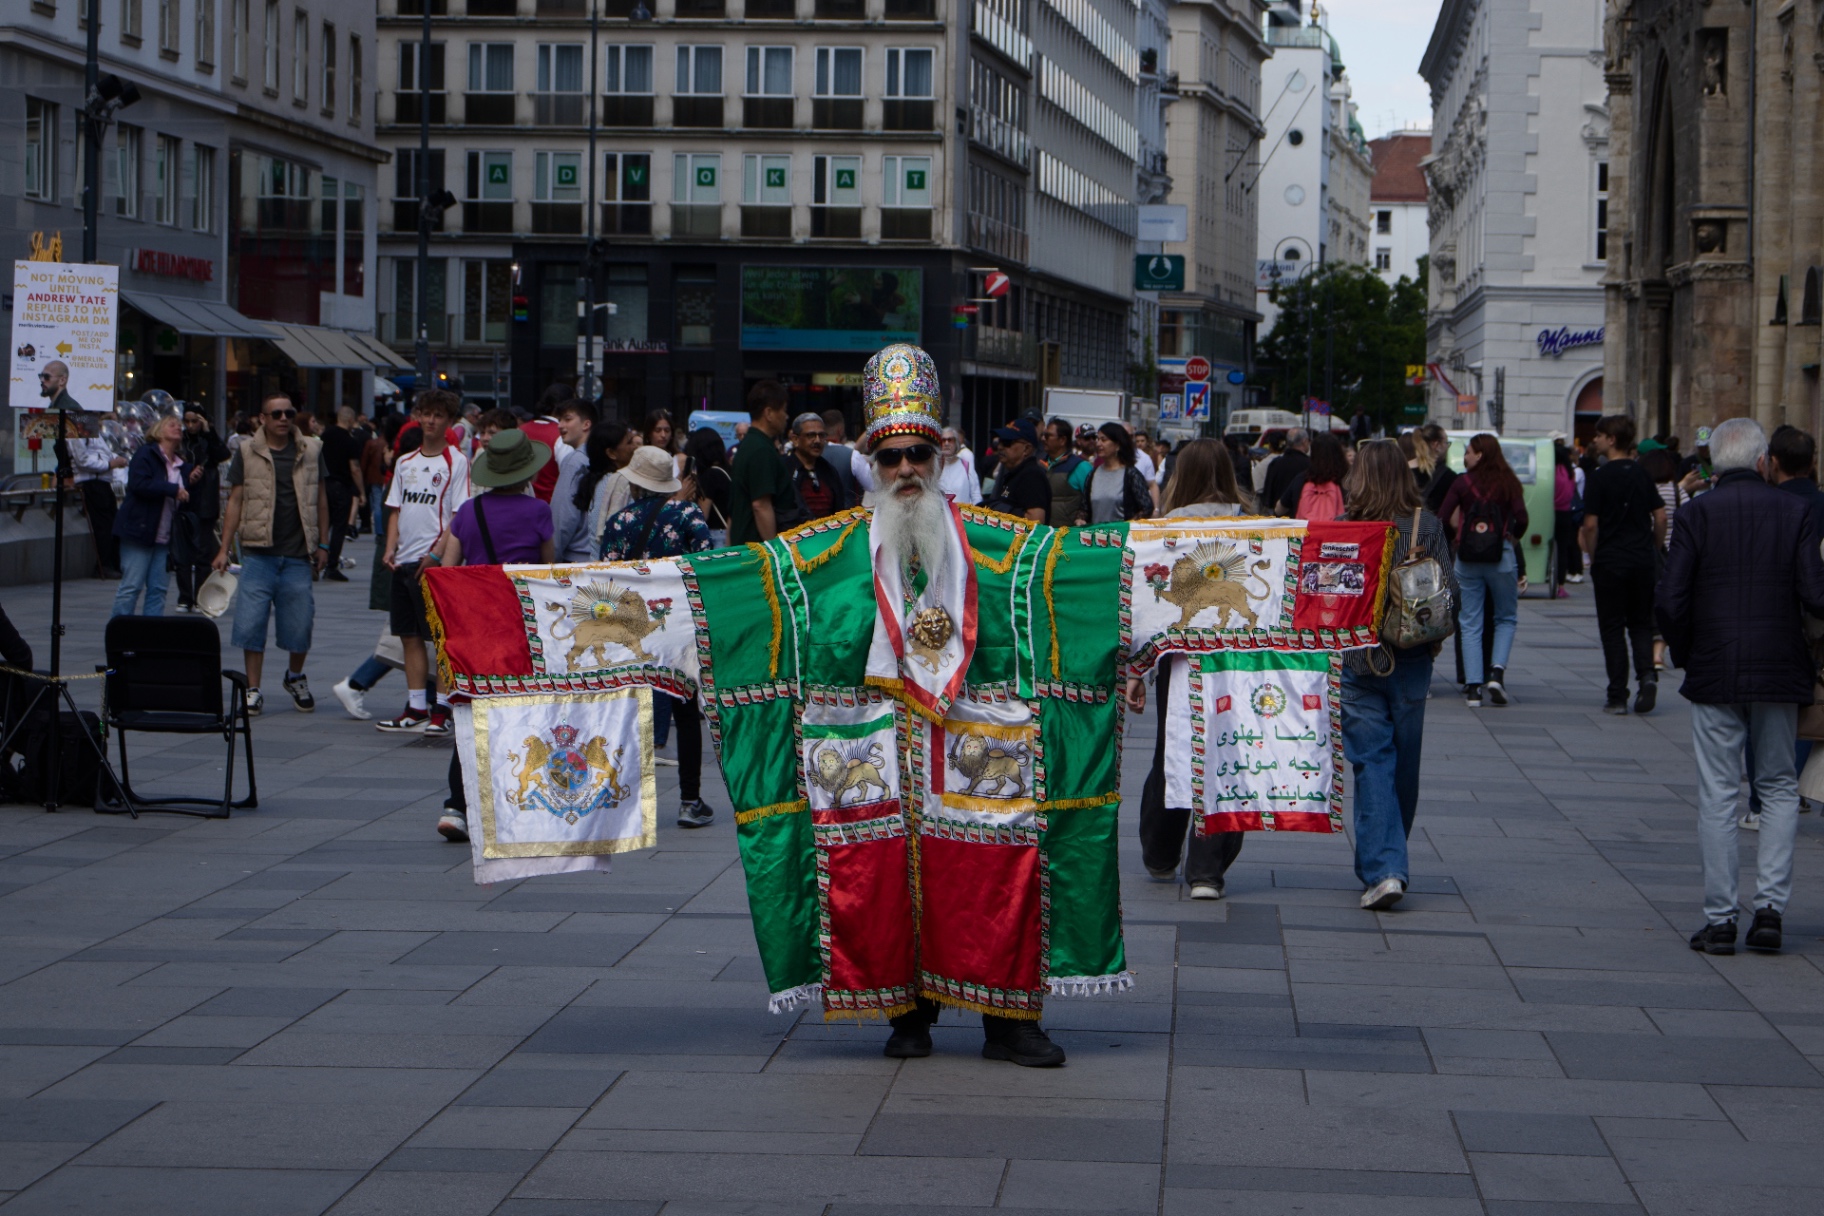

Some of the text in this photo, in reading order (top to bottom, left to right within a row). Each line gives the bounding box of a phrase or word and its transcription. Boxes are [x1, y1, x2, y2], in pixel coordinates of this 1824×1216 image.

[30, 273, 105, 286] NOT MOVING
[49, 284, 82, 294] UNTIL
[27, 292, 106, 305] ANDREW TATE
[27, 303, 109, 315] REPLIES TO MY
[22, 312, 110, 325] INSTAGRAM DM
[71, 330, 109, 338] POST/ADD
[603, 337, 669, 351] ank Austria
[1537, 326, 1605, 355] Manne
[69, 361, 109, 369] VIERTAUER
[1187, 364, 1209, 375] STOP
